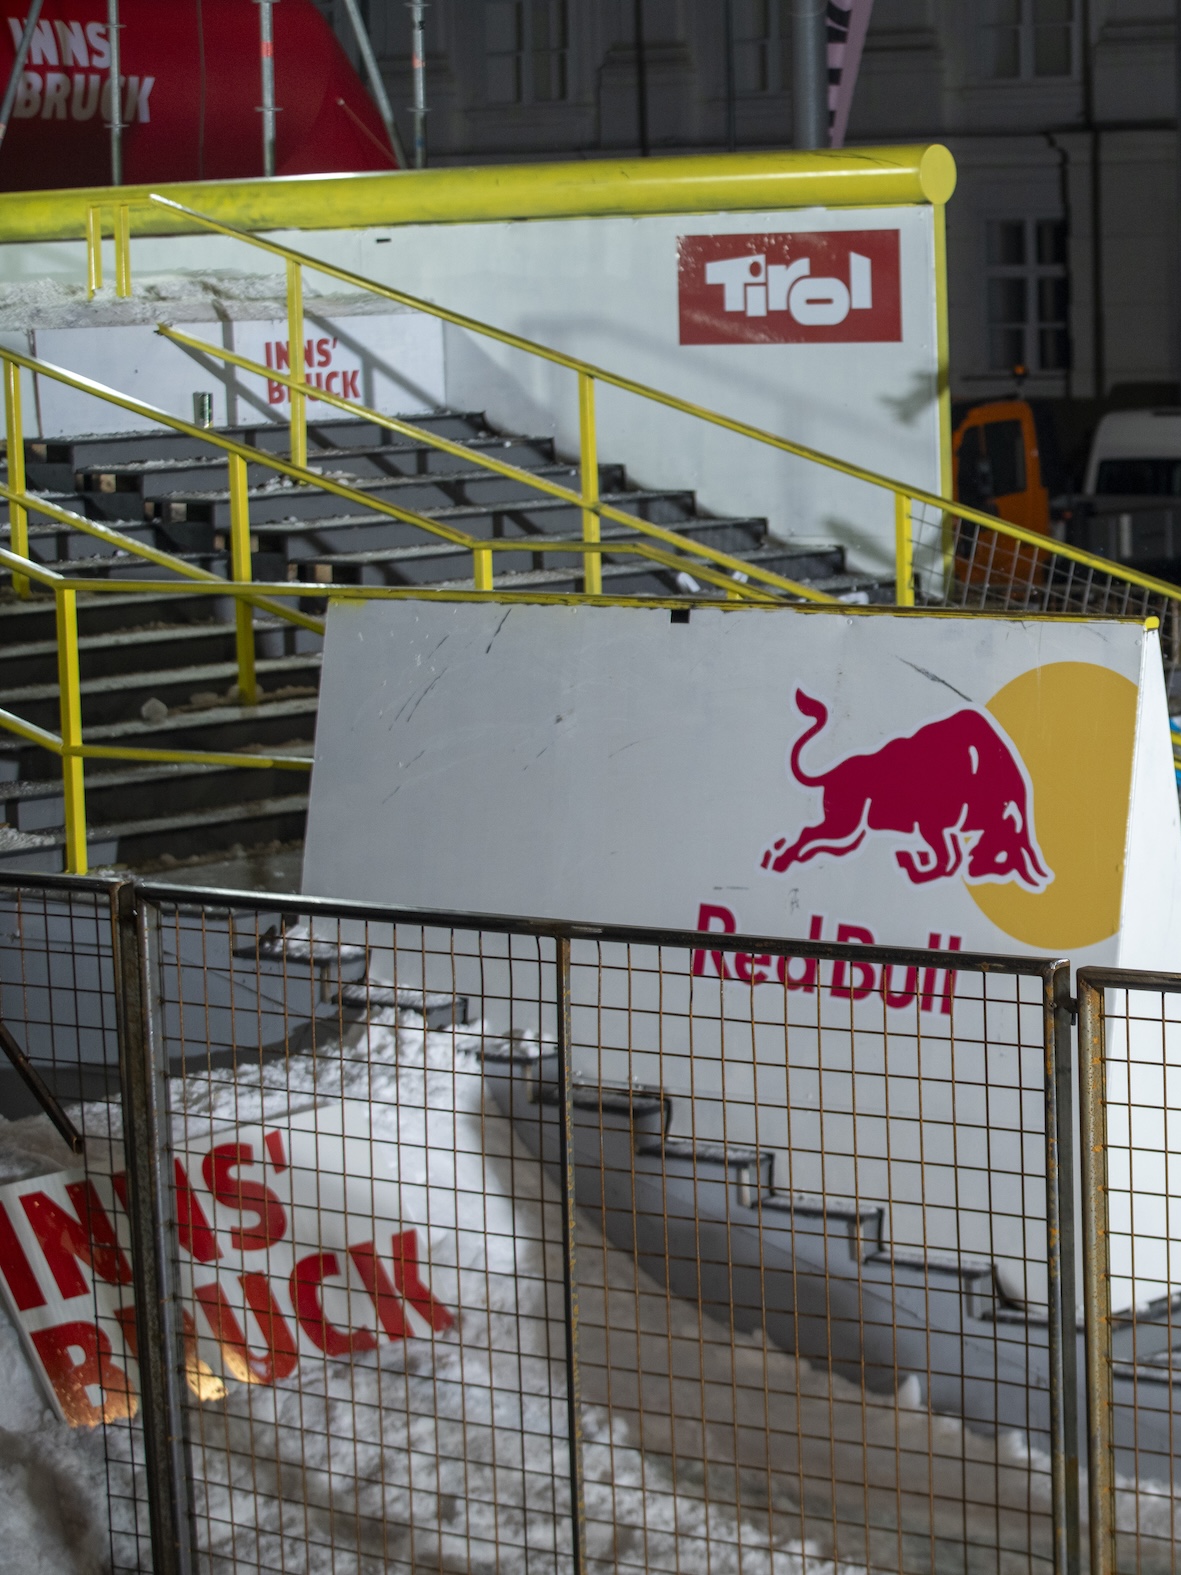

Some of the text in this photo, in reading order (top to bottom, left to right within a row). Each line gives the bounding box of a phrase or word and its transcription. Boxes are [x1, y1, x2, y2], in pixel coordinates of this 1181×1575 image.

[705, 251, 872, 326] Tirol
[267, 369, 361, 405] BUCK
[692, 903, 962, 1015] Red Bull
